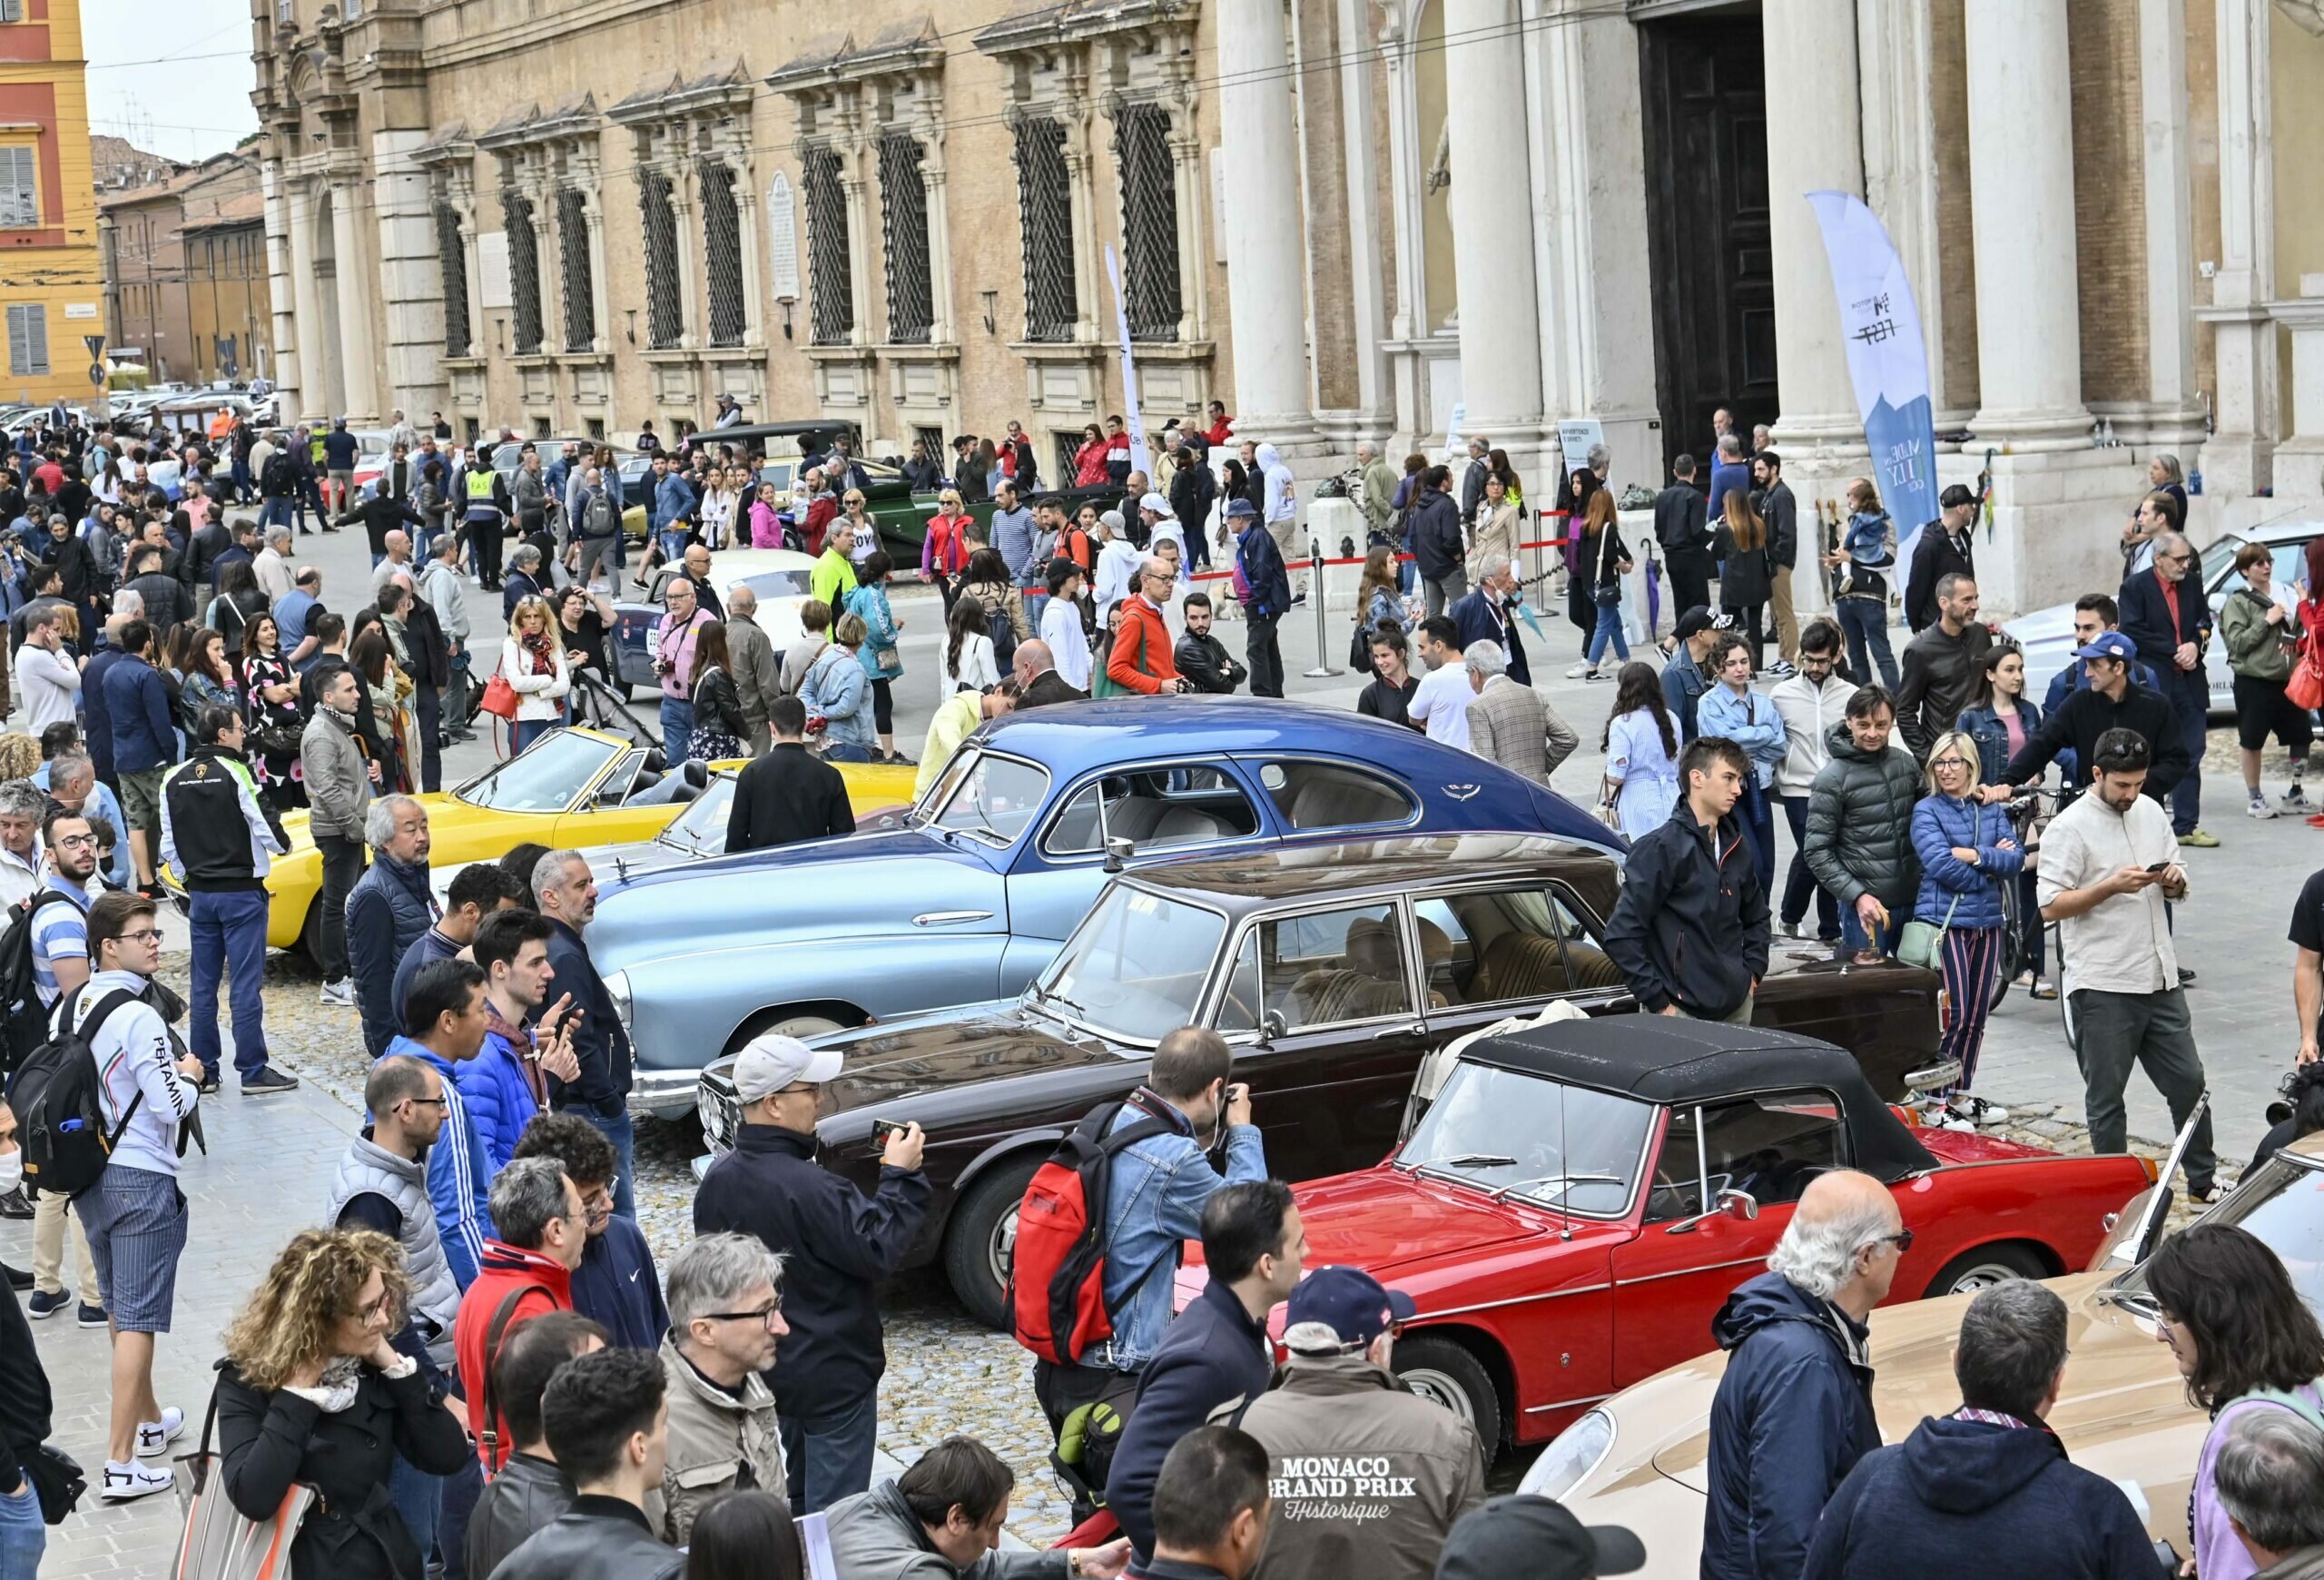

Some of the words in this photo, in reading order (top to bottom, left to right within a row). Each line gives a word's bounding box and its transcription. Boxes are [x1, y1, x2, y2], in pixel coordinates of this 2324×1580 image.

[471, 481, 487, 490] FAS
[1281, 1457, 1390, 1478] MONACO
[1354, 1477, 1416, 1497] PRIX
[1284, 1499, 1392, 1526] Historique
